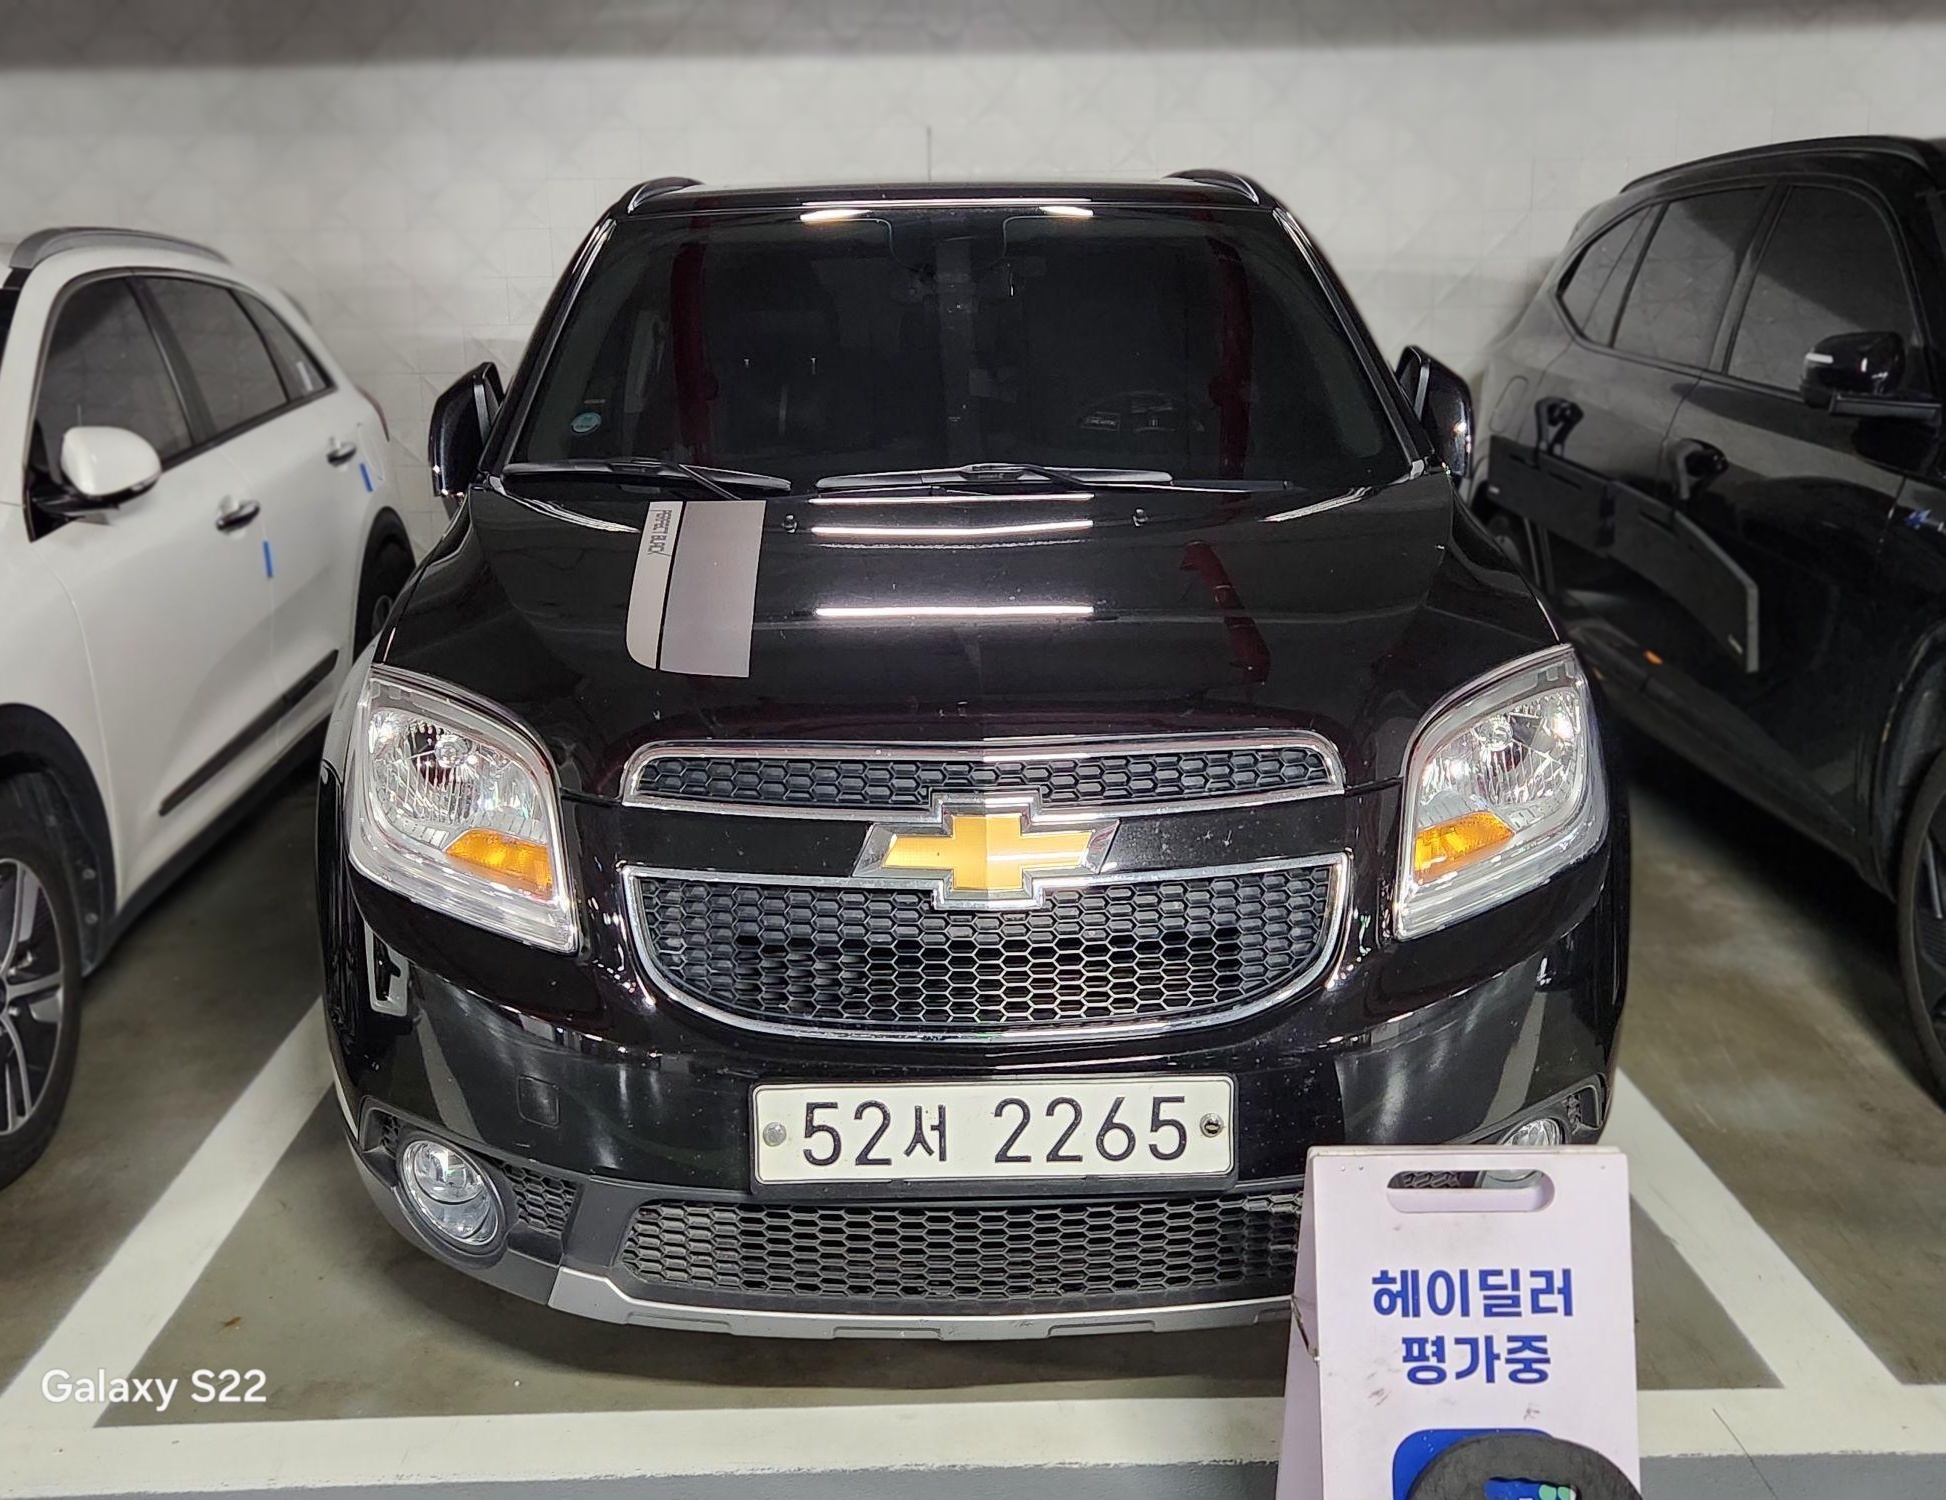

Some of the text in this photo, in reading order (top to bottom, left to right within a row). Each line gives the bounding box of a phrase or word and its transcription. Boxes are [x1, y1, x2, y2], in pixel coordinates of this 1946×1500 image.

[647, 535, 668, 556] BLACK
[802, 1095, 1188, 1166] 52서 2265
[1371, 1268, 1575, 1319] 헤이딜러
[1401, 1334, 1552, 1386] 평가중
